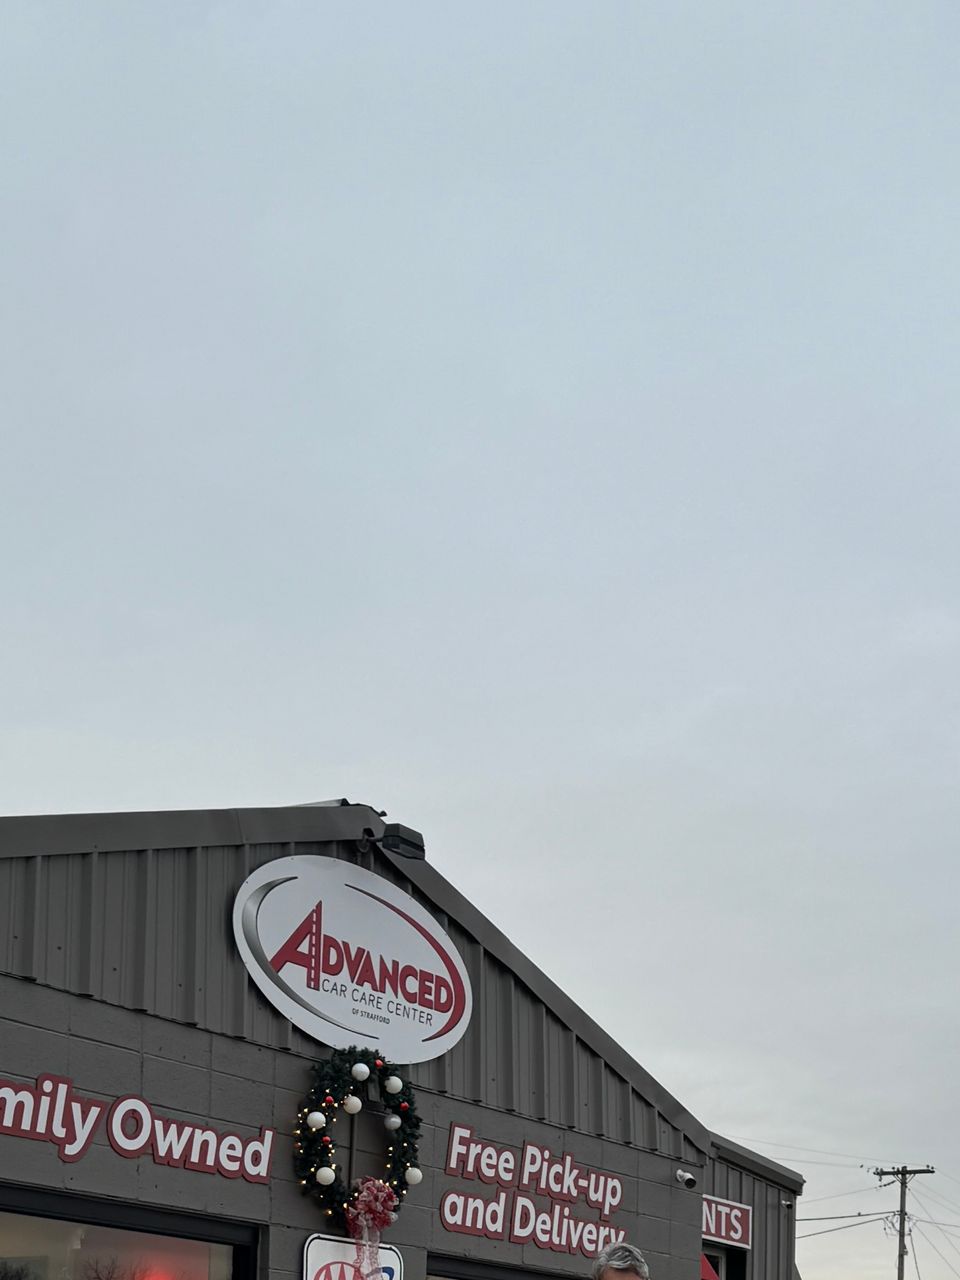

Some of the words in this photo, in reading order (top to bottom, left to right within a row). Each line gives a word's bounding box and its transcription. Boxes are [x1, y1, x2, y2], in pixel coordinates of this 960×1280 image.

[269, 900, 454, 1014] ADVANCED
[322, 979, 347, 999] CAR
[351, 988, 383, 1011] CARE
[387, 1000, 433, 1027] CENTER
[352, 1008, 360, 1016] OF
[360, 1010, 391, 1025] STRAFFORD
[112, 1099, 274, 1177] Owned
[450, 1126, 515, 1181] Free
[522, 1145, 622, 1215] Pick-up
[444, 1192, 506, 1233] and
[702, 1201, 743, 1240] NTS
